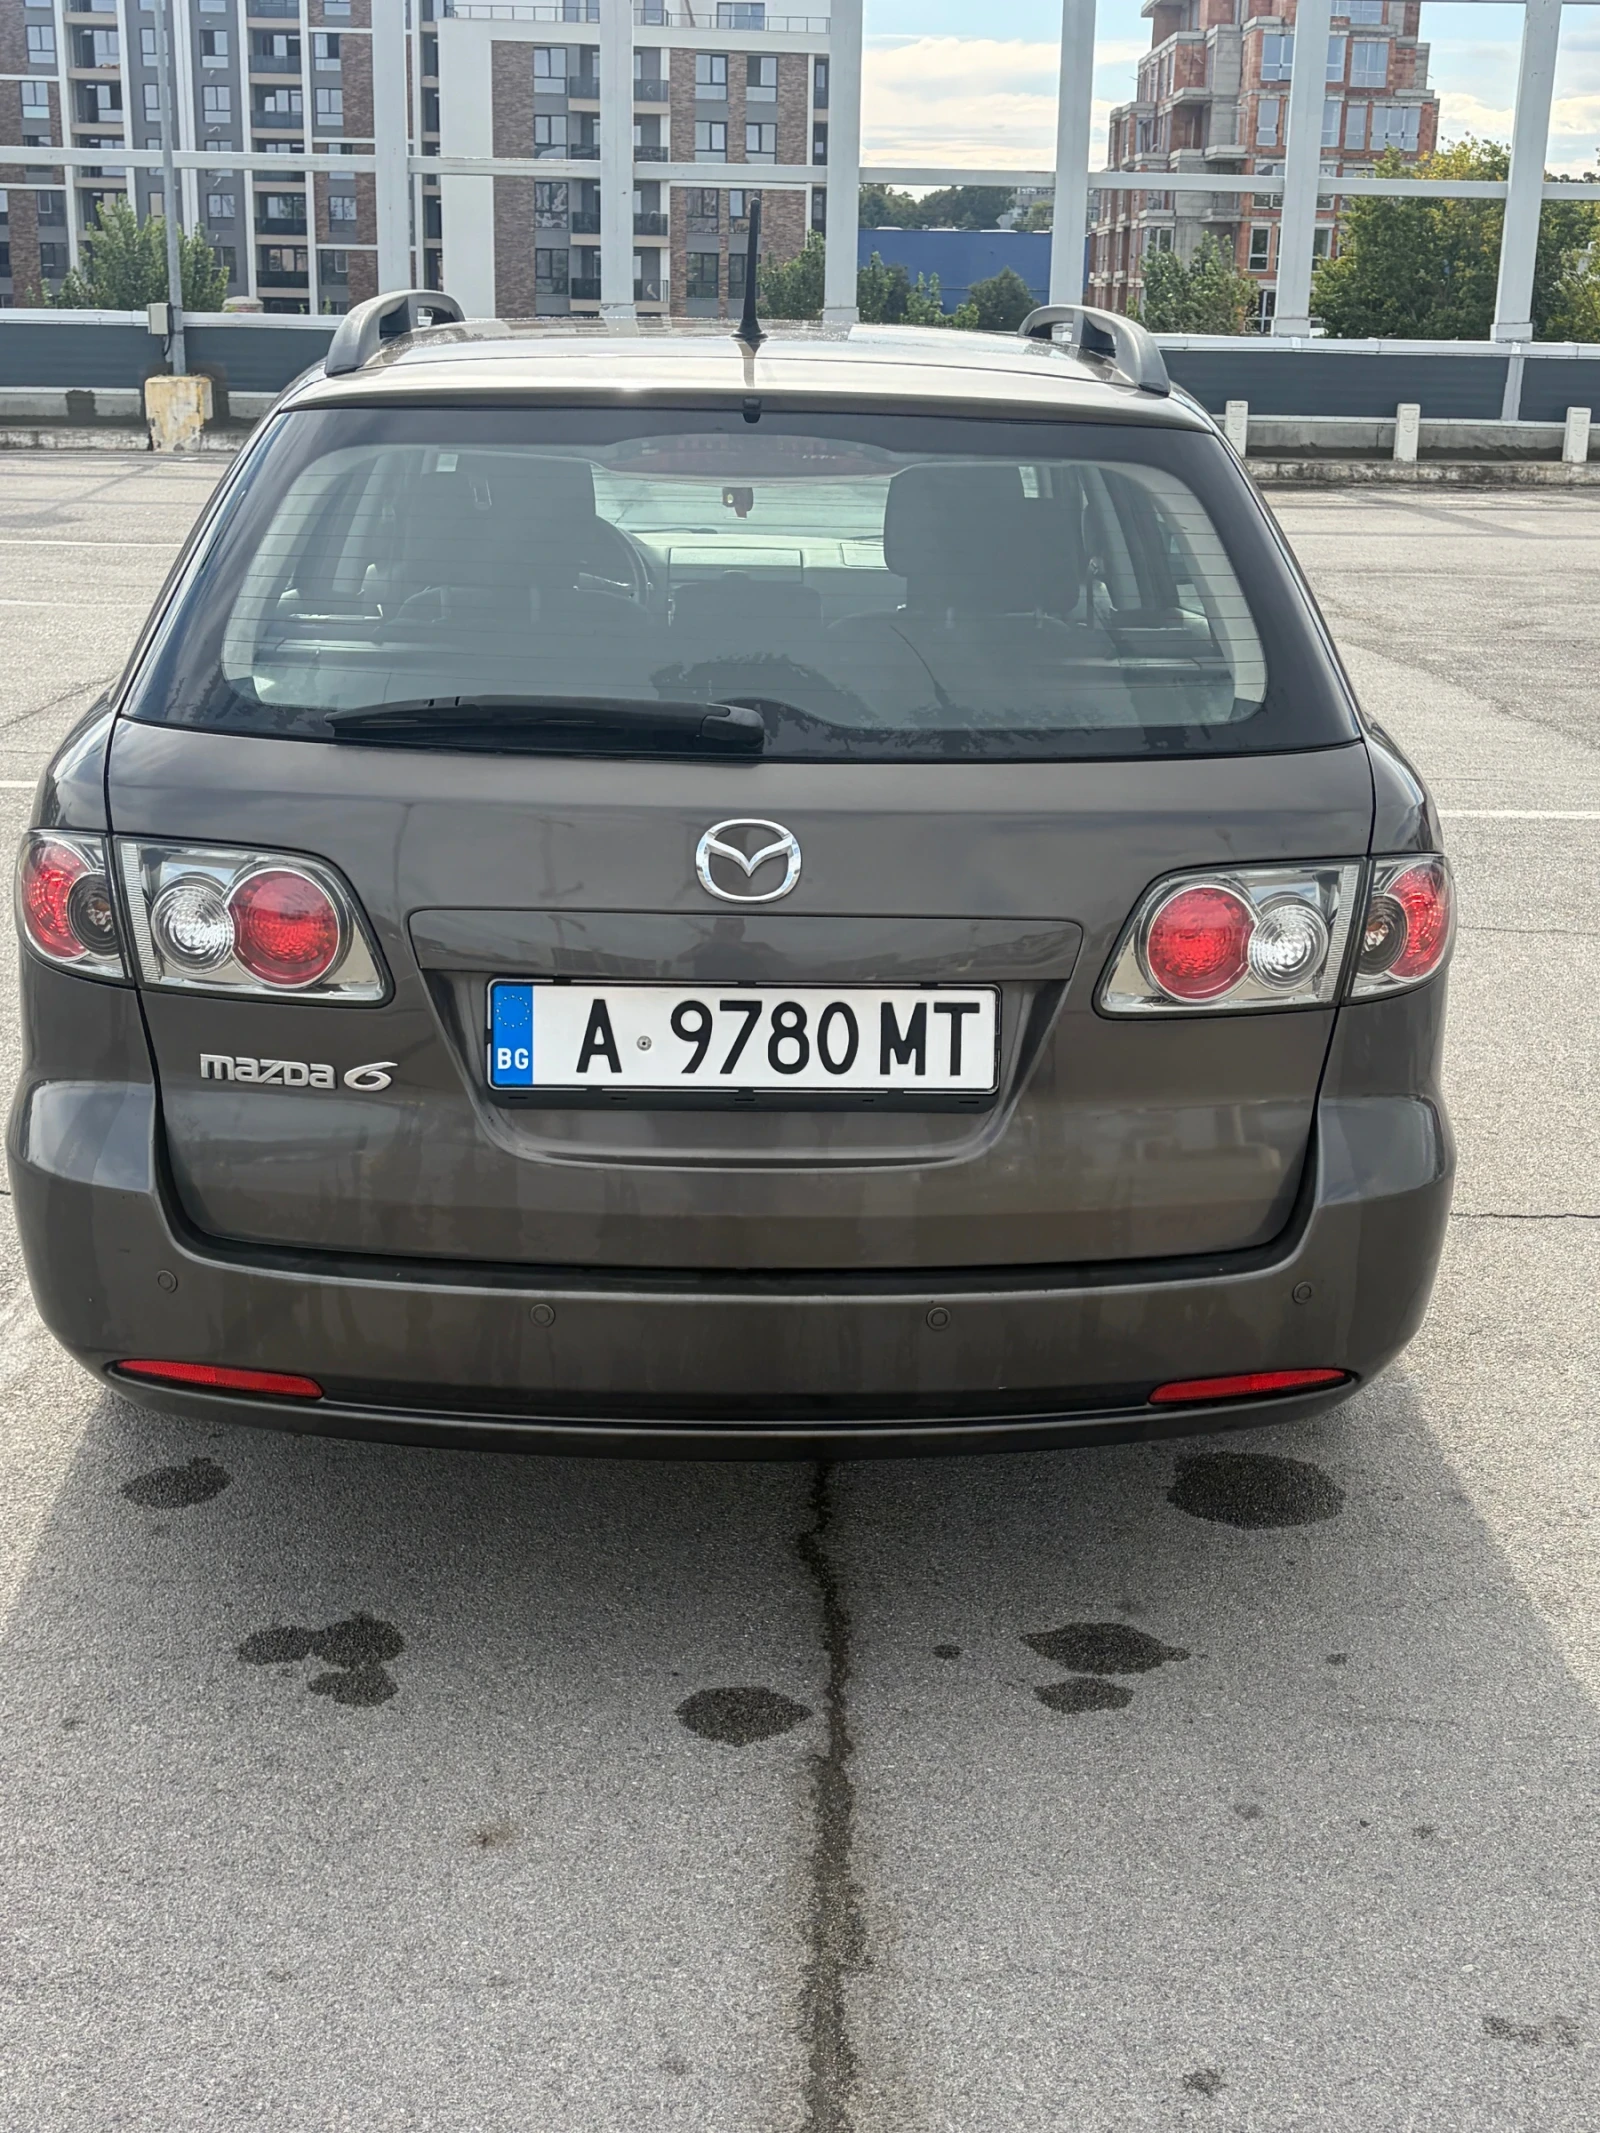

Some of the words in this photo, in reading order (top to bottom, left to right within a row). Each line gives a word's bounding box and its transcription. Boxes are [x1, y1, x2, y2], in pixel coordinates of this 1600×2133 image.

[576, 999, 622, 1074] A
[670, 1000, 859, 1075] 9780
[880, 1002, 980, 1077] MT
[496, 1048, 530, 1070] BG
[343, 1061, 398, 1091] 6
